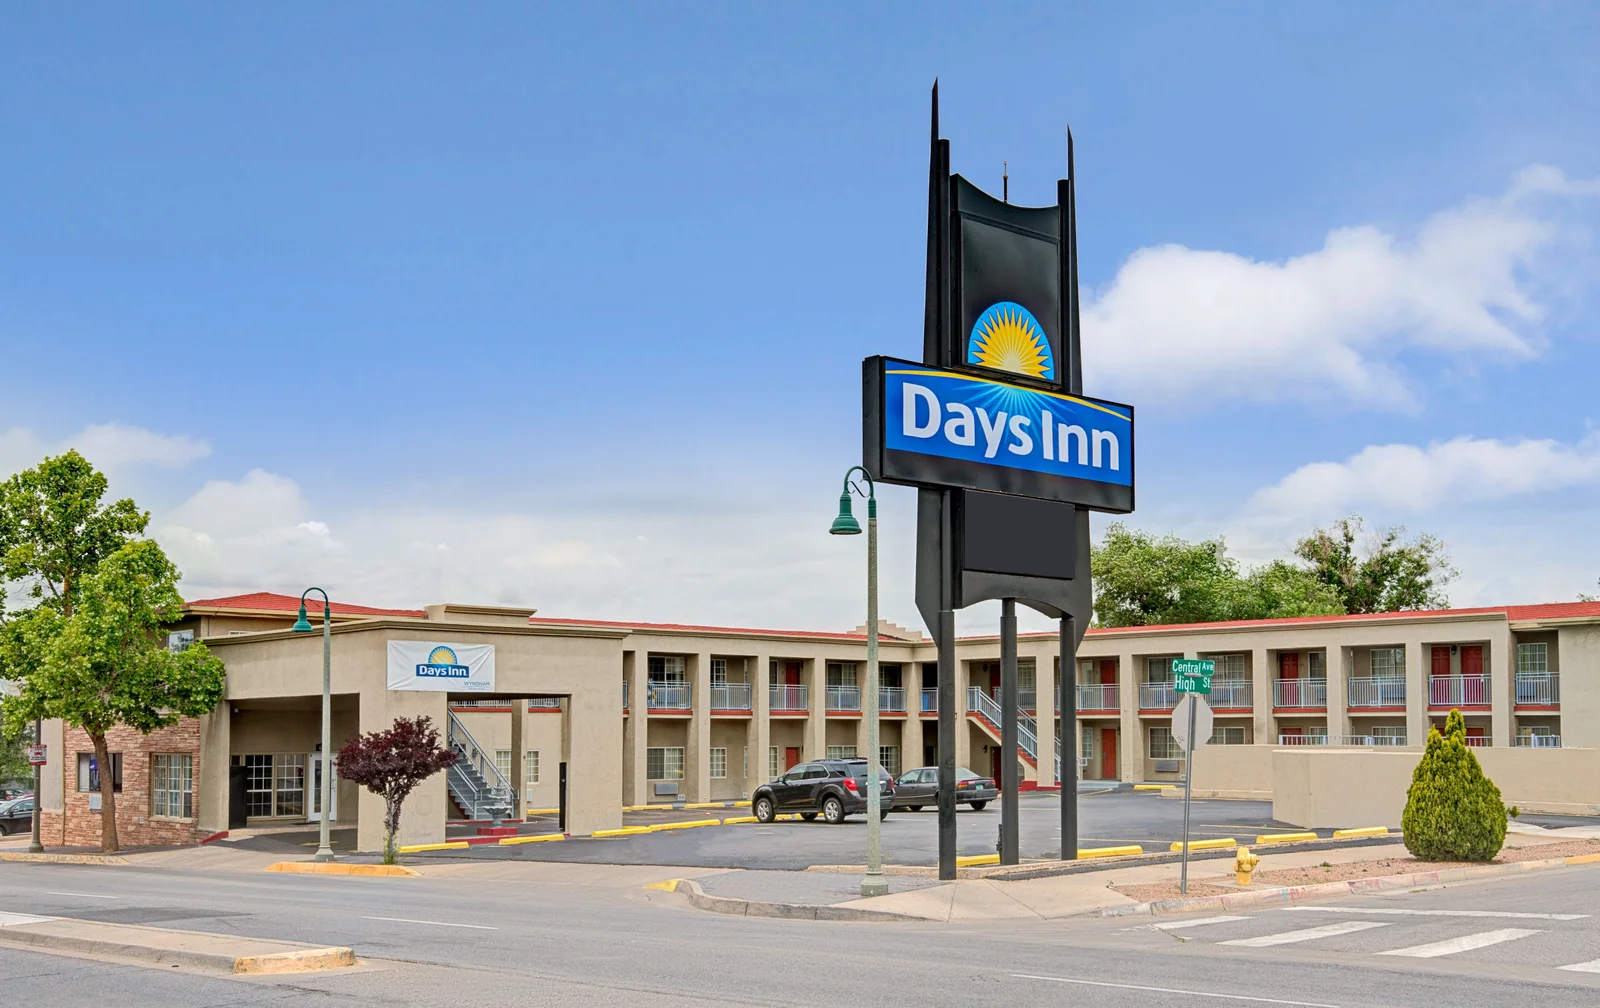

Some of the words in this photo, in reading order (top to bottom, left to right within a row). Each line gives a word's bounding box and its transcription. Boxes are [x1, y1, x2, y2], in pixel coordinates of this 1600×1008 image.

[902, 382, 1034, 459] Days
[1042, 409, 1120, 471] Inn
[419, 665, 447, 677] Days
[448, 666, 467, 676] Inn
[1172, 660, 1201, 674] Central
[1202, 663, 1214, 671] Ave
[1175, 674, 1195, 692] High
[1202, 676, 1211, 688] St
